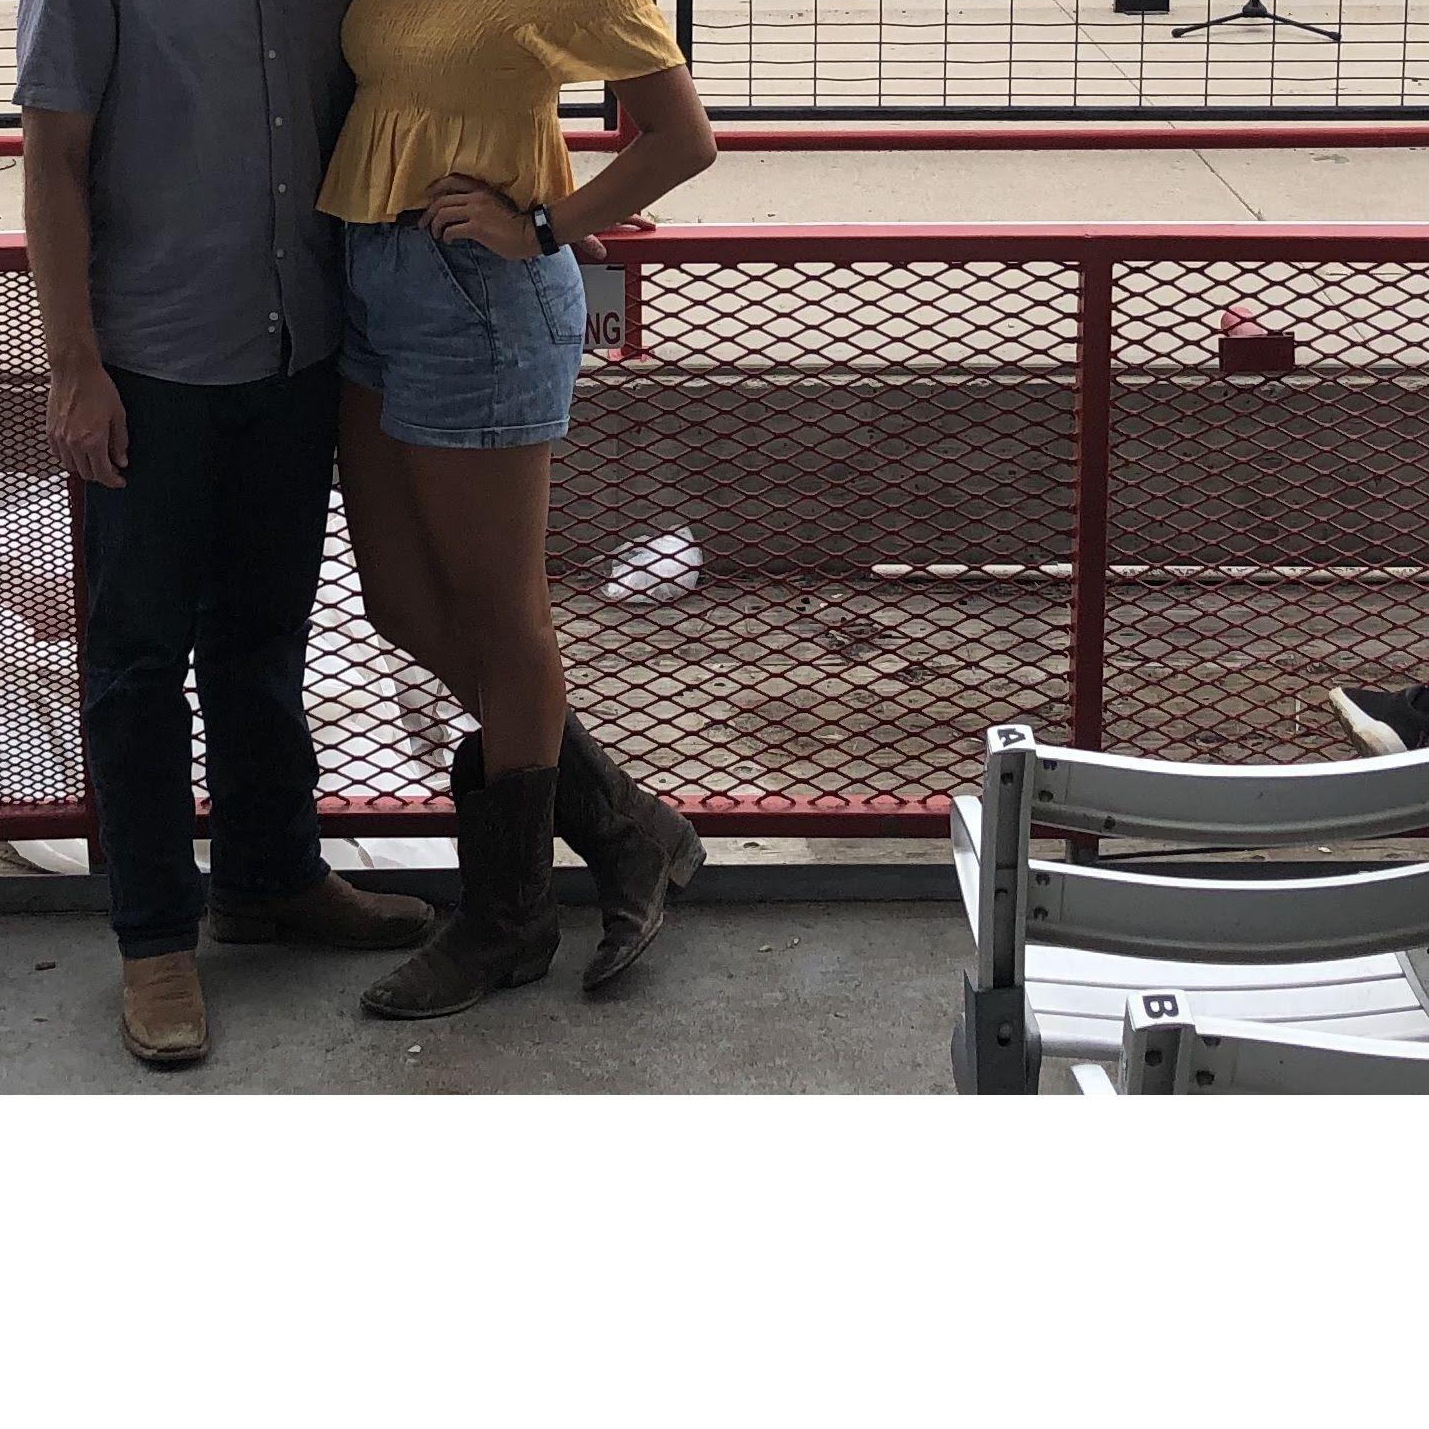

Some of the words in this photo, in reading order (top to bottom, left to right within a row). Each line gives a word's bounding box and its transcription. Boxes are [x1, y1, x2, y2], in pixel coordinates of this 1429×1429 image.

[585, 312, 621, 345] NG
[997, 728, 1026, 748] A
[1142, 994, 1180, 1020] B
